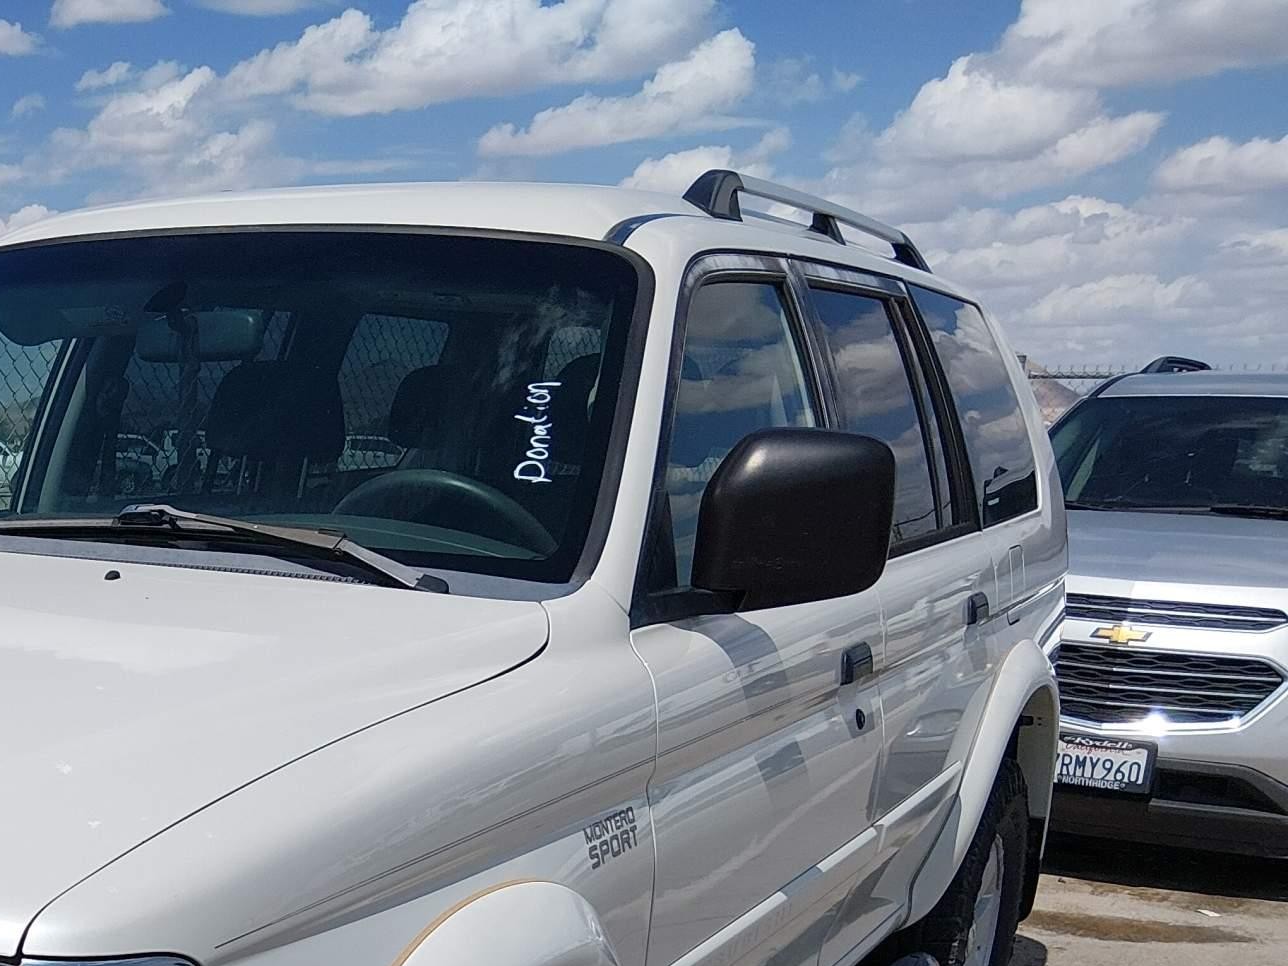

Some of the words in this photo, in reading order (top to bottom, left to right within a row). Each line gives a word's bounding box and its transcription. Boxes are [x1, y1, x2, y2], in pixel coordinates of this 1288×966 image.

[513, 381, 562, 483] Donation
[1062, 774, 1121, 790] NORTHRIDGE
[583, 806, 636, 846] MONTERO
[588, 824, 638, 870] SPORT
